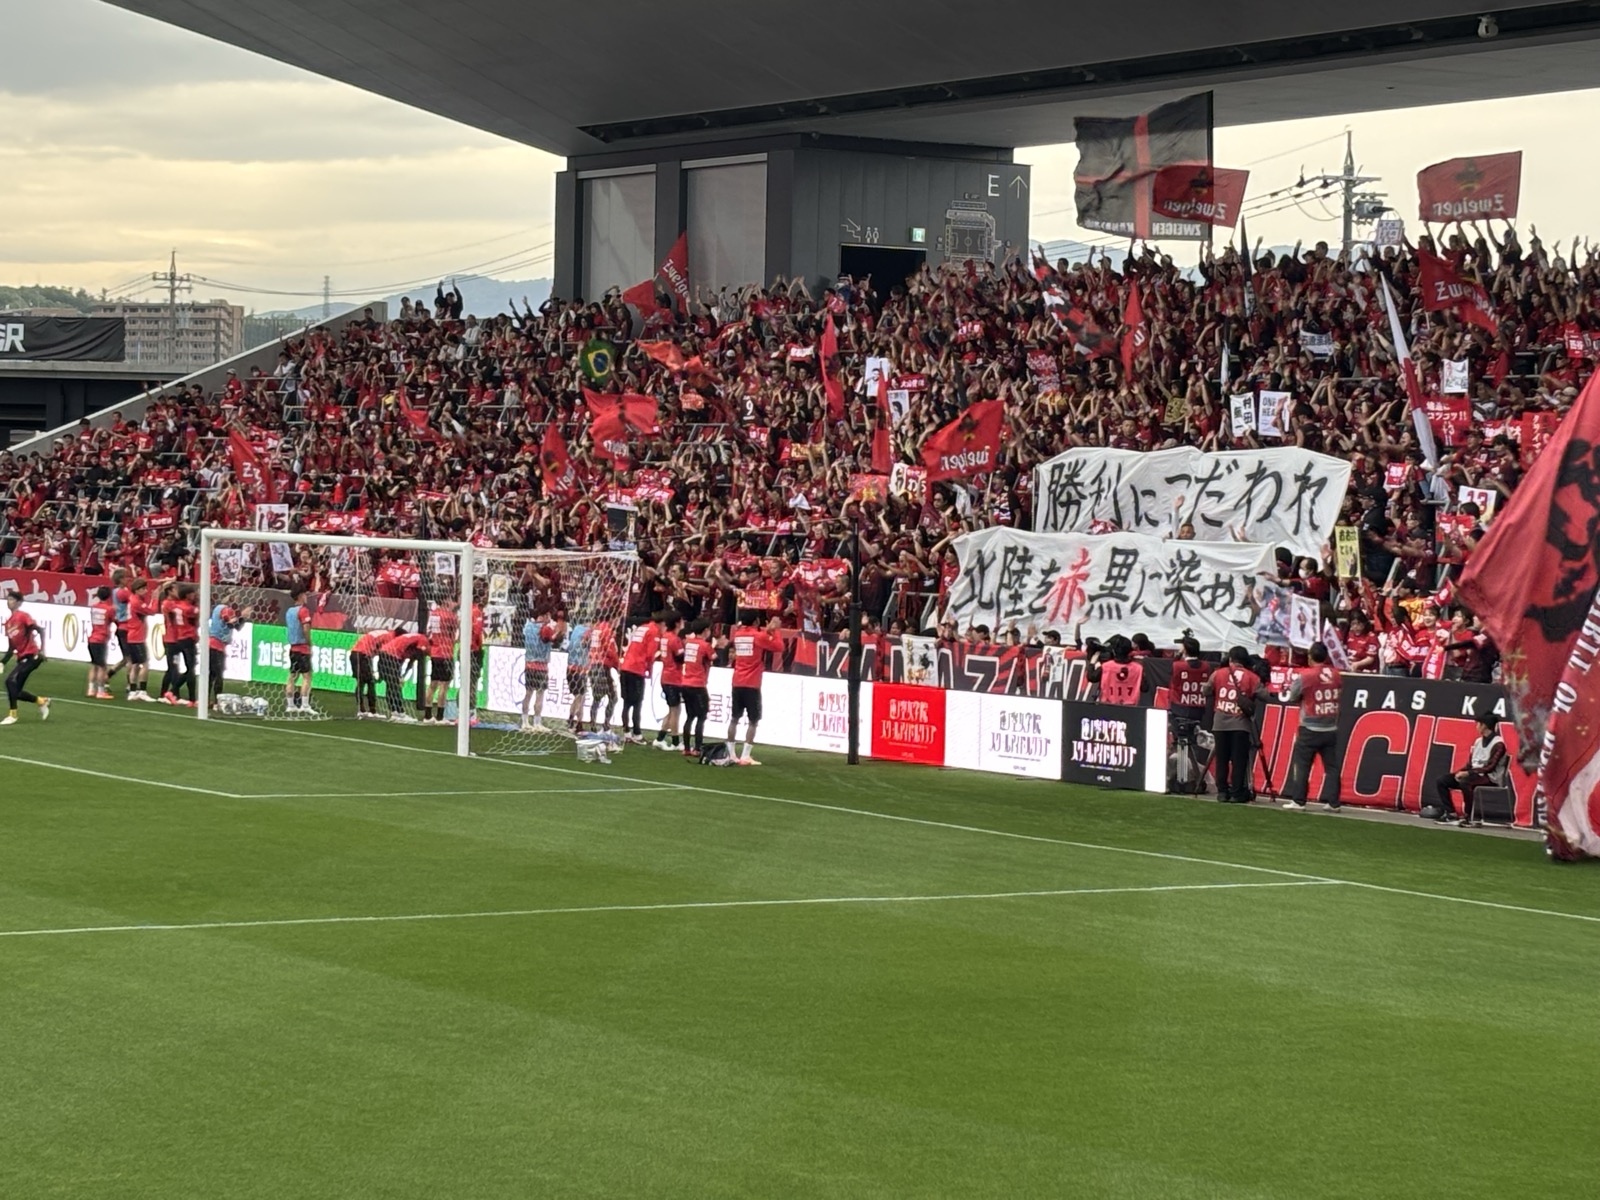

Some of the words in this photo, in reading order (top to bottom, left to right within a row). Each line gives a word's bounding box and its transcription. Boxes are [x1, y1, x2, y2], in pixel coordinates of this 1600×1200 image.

[988, 174, 1000, 197] E
[1043, 457, 1330, 536] 勝利にこだわれ
[1218, 687, 1238, 700] 00
